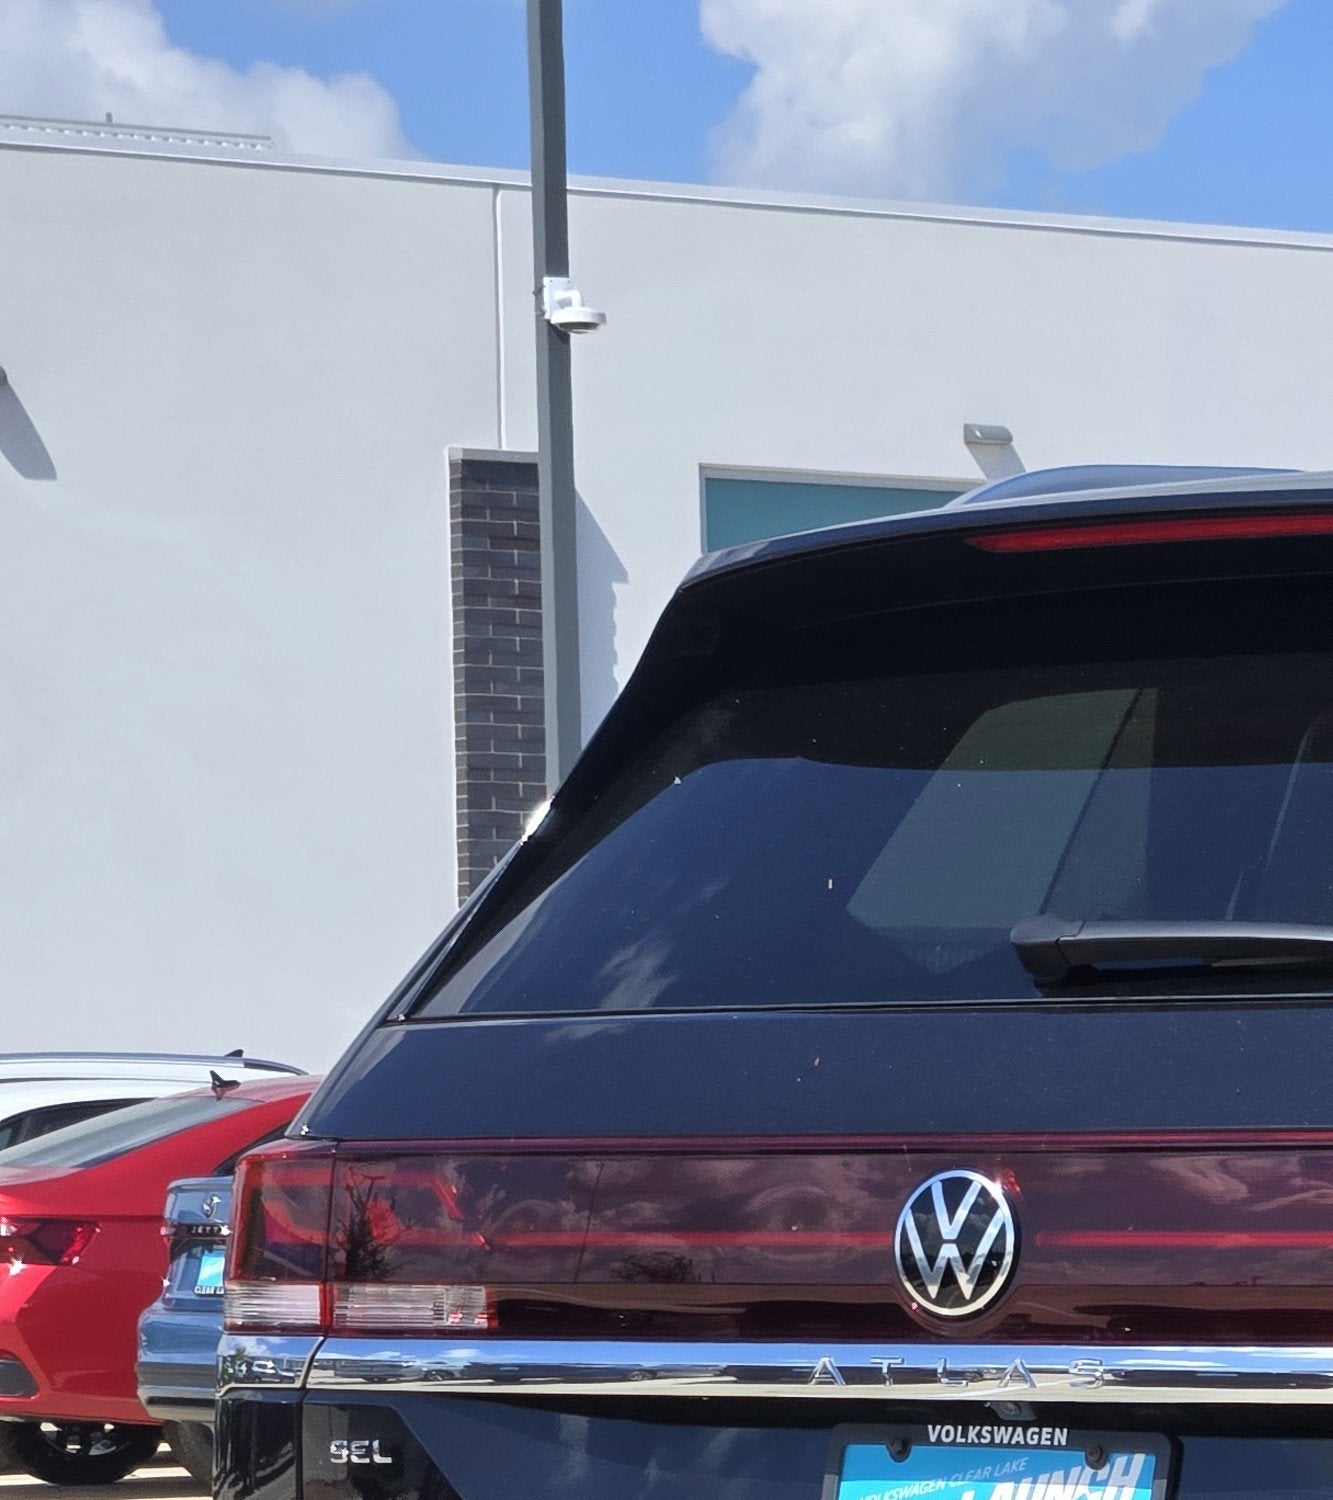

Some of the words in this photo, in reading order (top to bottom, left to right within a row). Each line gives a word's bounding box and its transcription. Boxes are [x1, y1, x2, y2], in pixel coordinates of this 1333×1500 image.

[191, 1225, 230, 1236] JETT
[808, 1356, 1105, 1389] ATLAS
[927, 1424, 1068, 1446] VOLKSWAGEN
[330, 1439, 393, 1464] SEL
[948, 1466, 991, 1487] CLEAR
[994, 1457, 1030, 1477] LAKE
